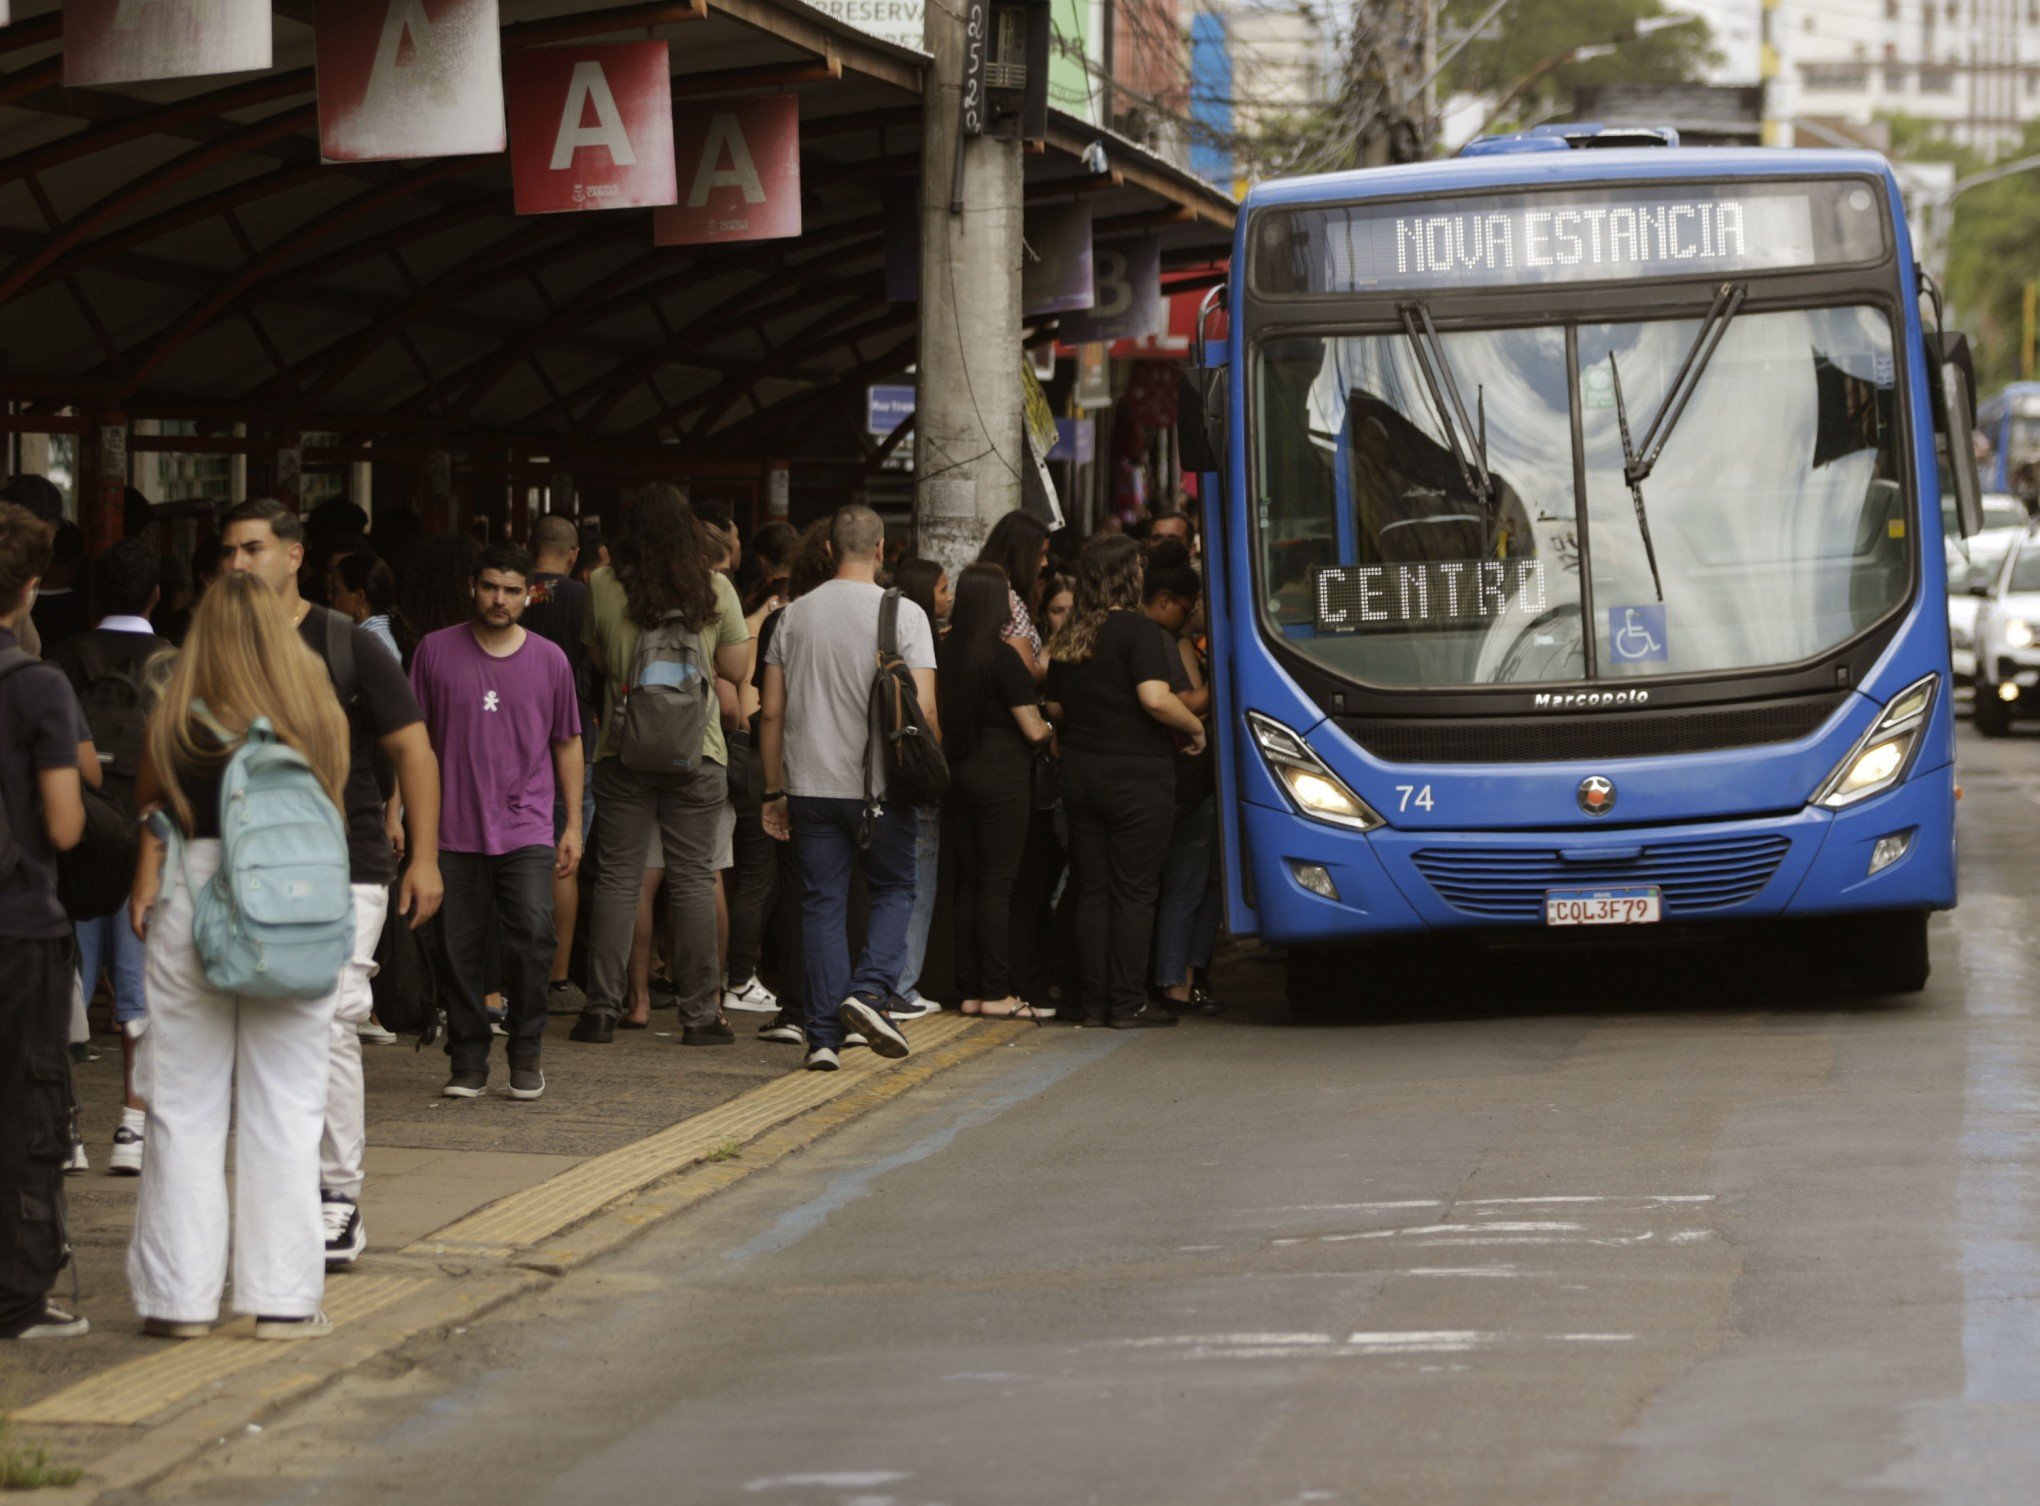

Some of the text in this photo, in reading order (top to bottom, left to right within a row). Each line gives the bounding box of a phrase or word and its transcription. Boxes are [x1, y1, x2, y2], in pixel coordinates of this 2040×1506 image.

[359, 0, 460, 108] A
[550, 60, 638, 170] A
[687, 112, 767, 208] A
[1397, 202, 1745, 272] NOVA ESTANCIA
[1318, 559, 1546, 622] CENTRO
[1535, 689, 1648, 708] Marcopolo
[1395, 785, 1435, 812] 74
[1556, 900, 1648, 921] COL3F79
